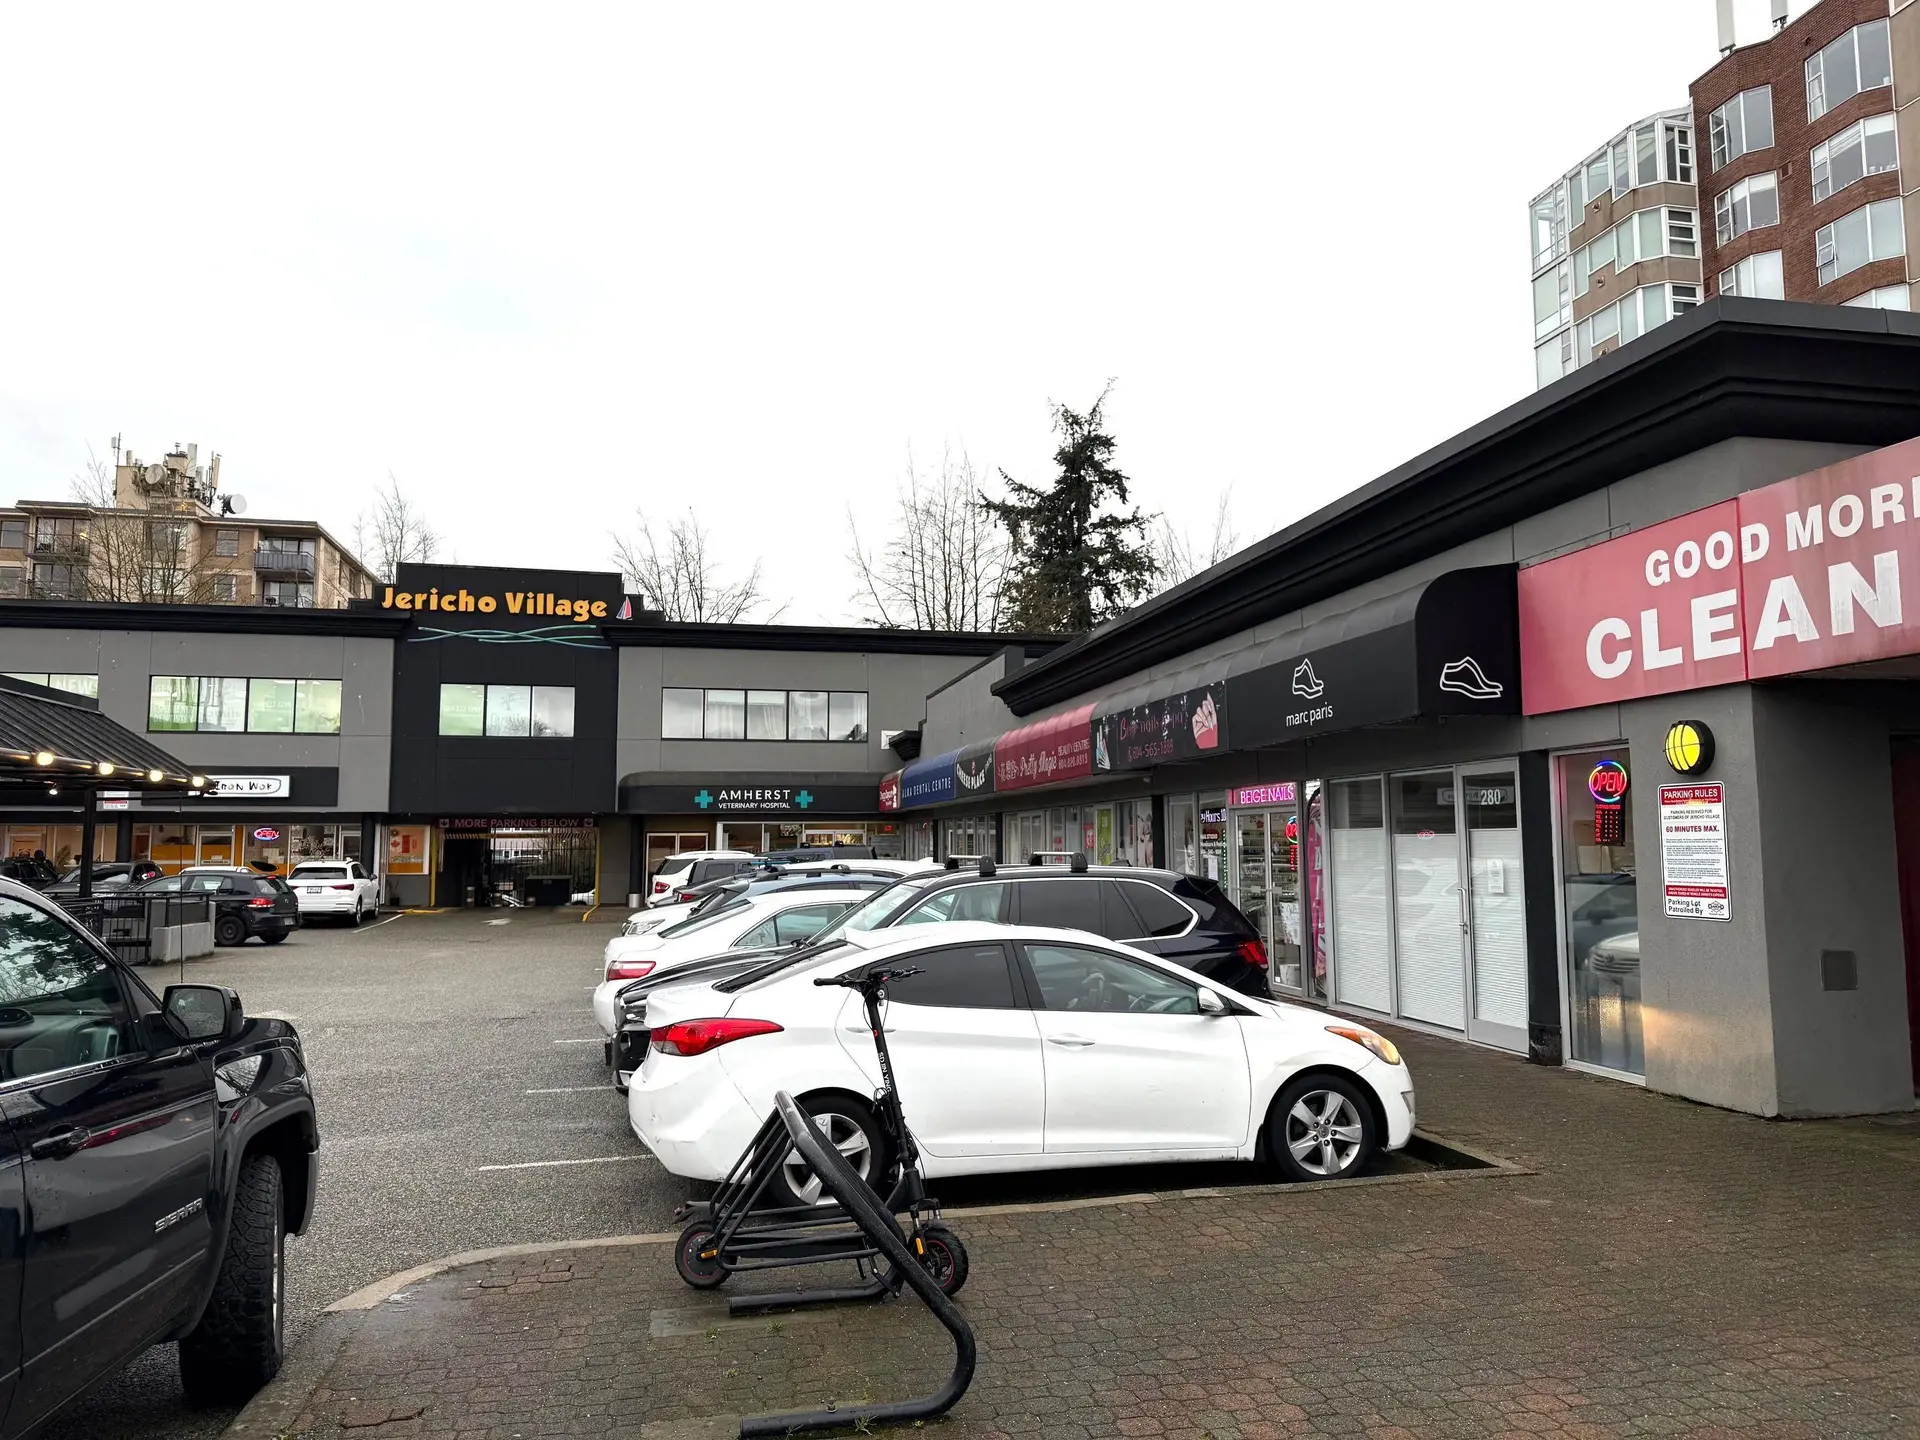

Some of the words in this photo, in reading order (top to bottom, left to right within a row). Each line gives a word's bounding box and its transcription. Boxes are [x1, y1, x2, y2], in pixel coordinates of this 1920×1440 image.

[1645, 522, 1770, 587] GOOD
[1785, 476, 1920, 552] MOR
[381, 587, 498, 613] Jericho
[505, 591, 608, 622] Village
[1585, 549, 1904, 680] CLEAN
[1285, 711, 1309, 727] marc
[1309, 701, 1334, 726] paris
[913, 782, 931, 796] DENTAL
[931, 777, 951, 792] CENTRE
[971, 768, 986, 790] PLACE
[1591, 771, 1623, 792] OPEN
[718, 789, 791, 800] AMHERST
[1240, 788, 1266, 805] BEIGE
[1268, 785, 1295, 802] NAILS
[1480, 788, 1501, 806] 280
[1664, 790, 1693, 799] PARKING
[1694, 788, 1718, 798] RULES
[454, 818, 488, 828] MORE
[490, 818, 538, 828] PARKING
[540, 818, 578, 828] BELOW
[255, 828, 280, 839] OPEN
[1667, 898, 1690, 907] Parking
[1690, 899, 1701, 907] Lot
[1668, 906, 1694, 914] Patrolled
[1694, 907, 1703, 915] By
[154, 1197, 203, 1234] SIERRA
